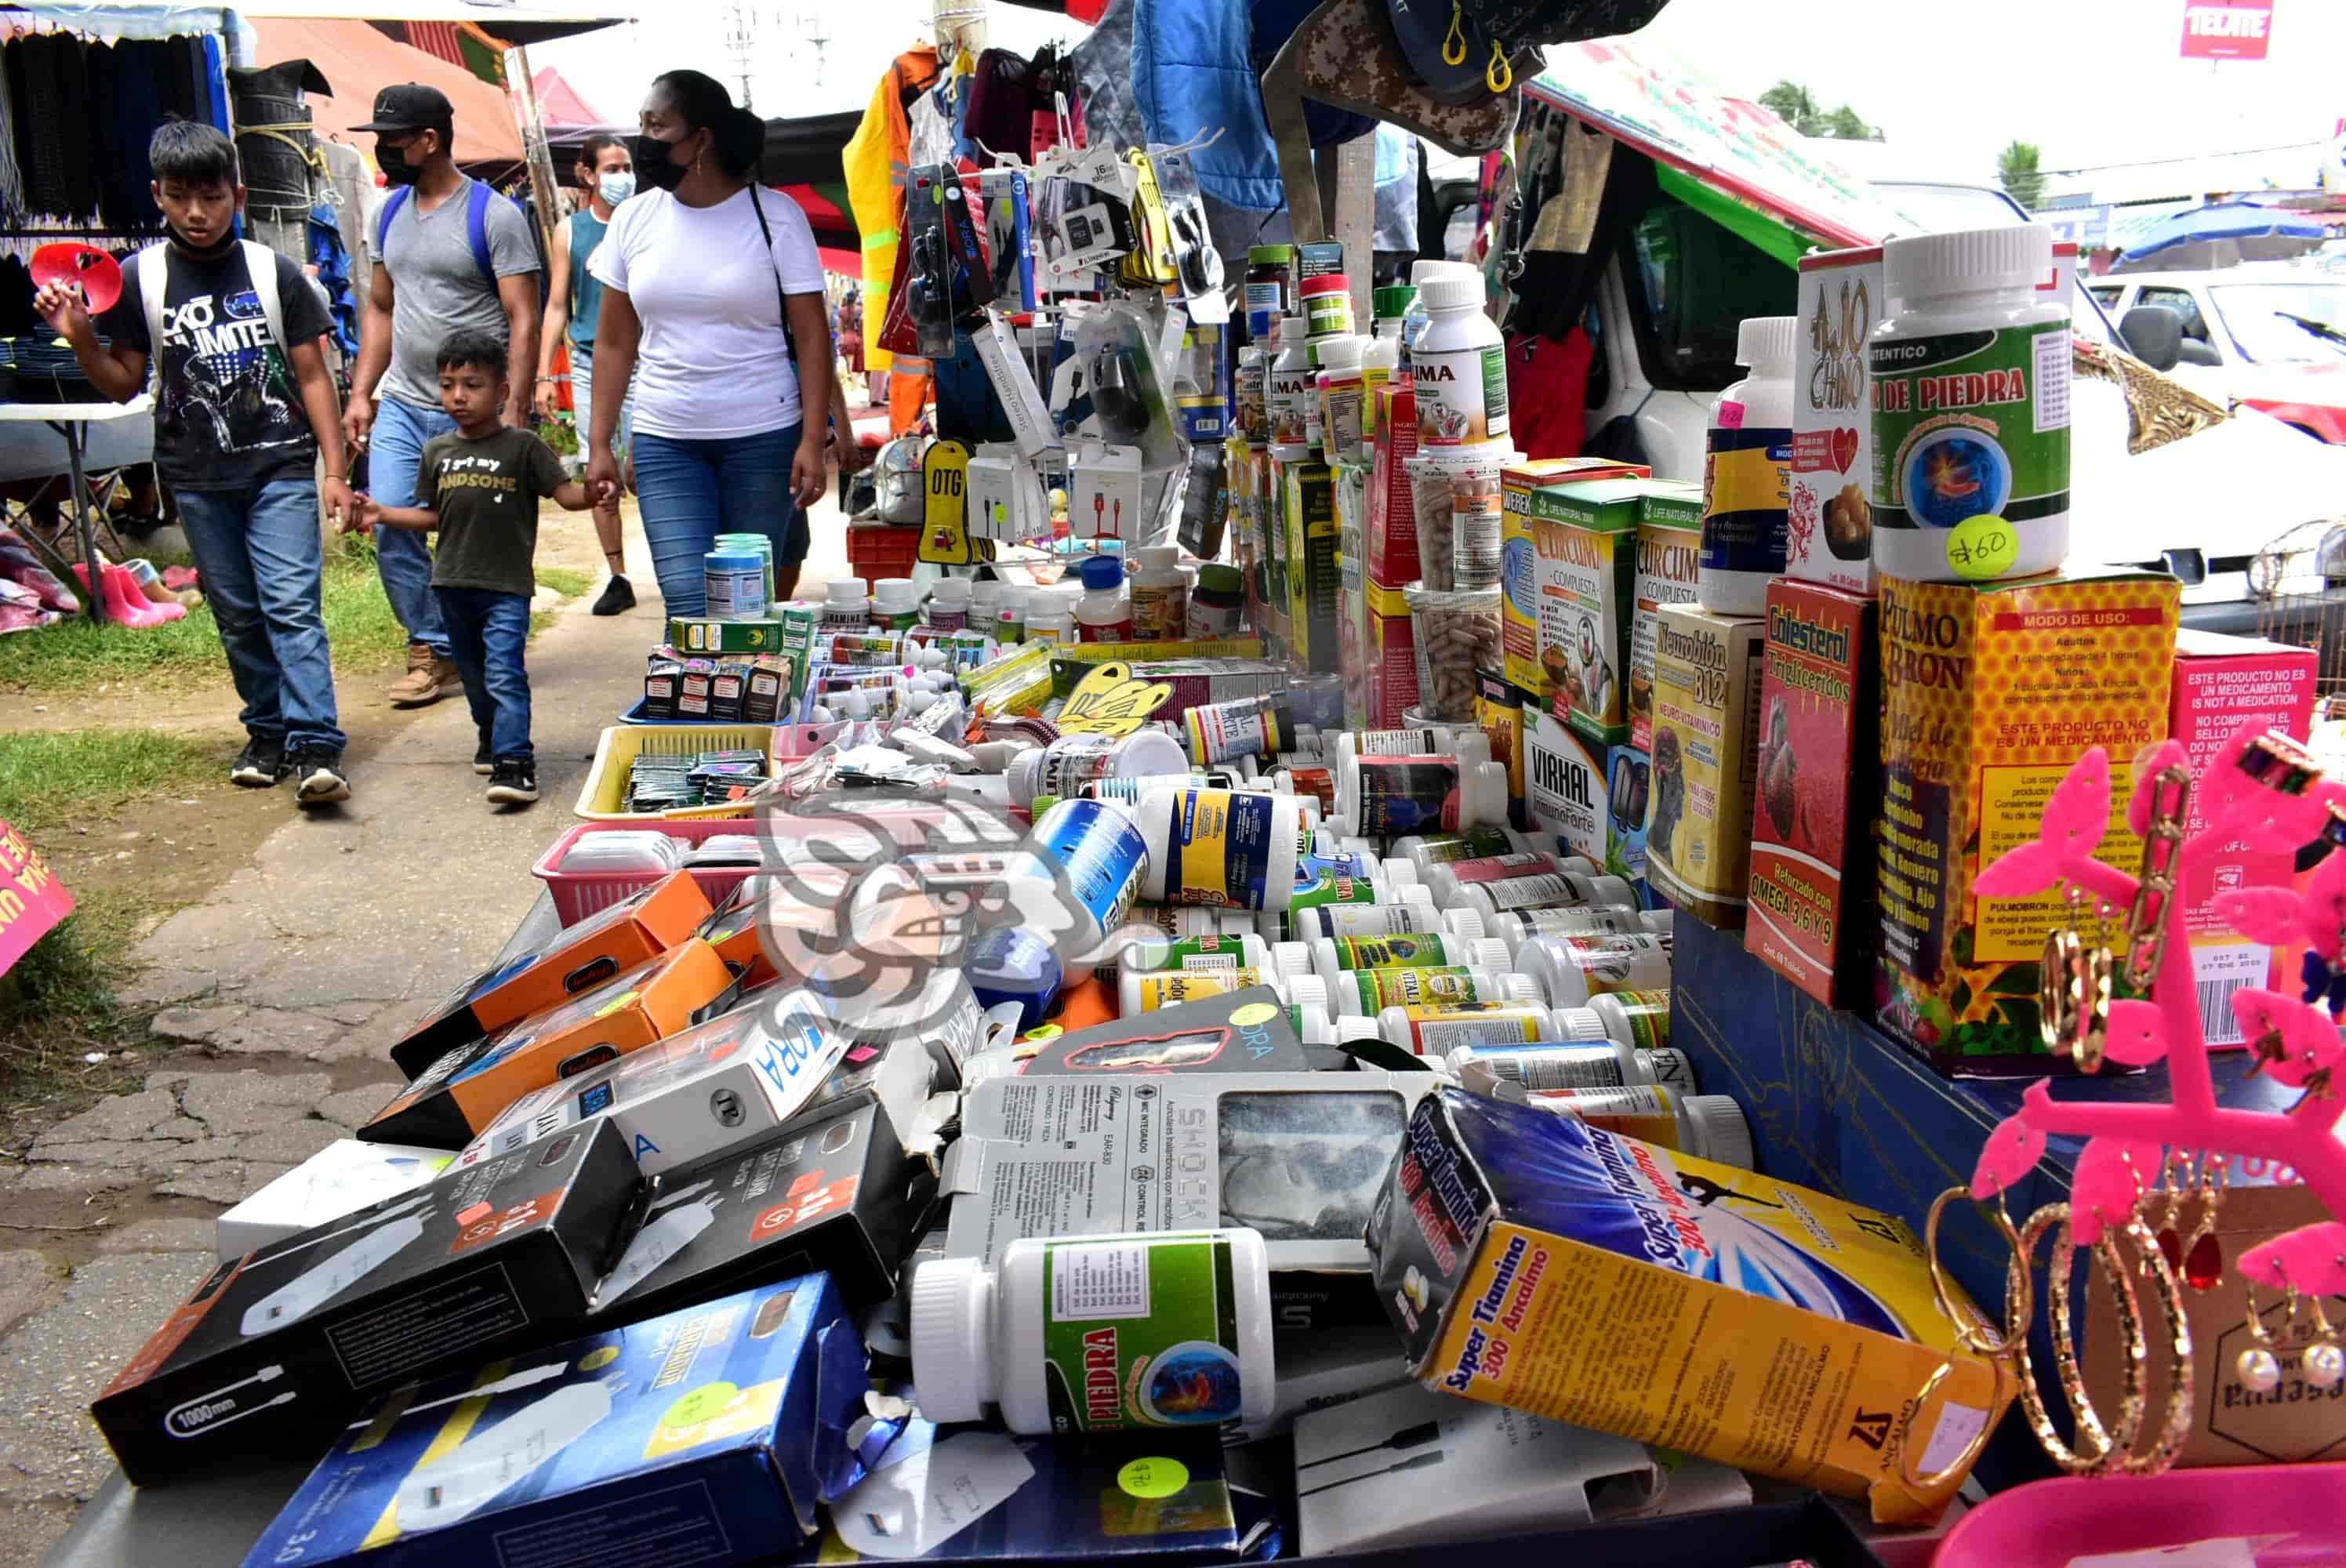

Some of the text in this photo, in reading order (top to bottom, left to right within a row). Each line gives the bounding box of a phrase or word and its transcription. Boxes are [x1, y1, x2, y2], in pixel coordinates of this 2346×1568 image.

[1870, 345, 1927, 361] UTENTICO
[1884, 379, 1911, 413] DE
[1917, 368, 2027, 411] PIEDRA
[477, 458, 500, 472] my
[931, 468, 961, 496] OTG
[1768, 604, 1850, 667] Colesterol
[1882, 589, 1959, 649] PULMO
[2024, 613, 2131, 627] MODO DE USO:
[1887, 640, 1966, 691] BRON
[2188, 669, 2306, 686] ESTE PRODUCTO NO ES
[1692, 666, 1727, 711] B12
[2192, 694, 2298, 711] IS NOT A MEDICATION
[2200, 682, 2292, 697] UN MEDICAMENTO
[2000, 719, 2150, 735] ESTE PRODUCTO NO
[2195, 714, 2212, 728] NO
[2279, 712, 2291, 724] EL
[2195, 728, 2228, 741] SELLO
[1996, 733, 2152, 749] ES UN MEDICAMENTO
[2190, 741, 2205, 753] DO
[2012, 786, 2049, 797] producto
[1774, 863, 1832, 914] Reforzado con
[1751, 873, 1791, 920] OMEGA
[1812, 910, 1822, 939] Y
[1821, 918, 1833, 946] 9
[1990, 903, 2049, 912] PULMOBRON
[1139, 1101, 1149, 1154] MIC INTEGRADO
[1165, 1099, 1176, 1138] Auriculares
[1102, 1134, 1114, 1166] EAR-830
[1582, 1123, 1650, 1200] Tiamina
[1164, 1179, 1173, 1197] con
[1409, 1102, 1480, 1250] Super Tiamina
[1629, 1144, 1690, 1211] Ancalmo
[1136, 1184, 1147, 1221] CONTROL
[1411, 1188, 1457, 1279] Ancalmo
[1625, 1198, 1688, 1271] Super
[1500, 1247, 1550, 1334] Ancalmo
[1445, 1233, 1530, 1392] Super Tiamina
[1082, 1326, 1122, 1423] PIEDRA
[176, 1397, 238, 1430] 1000mm
